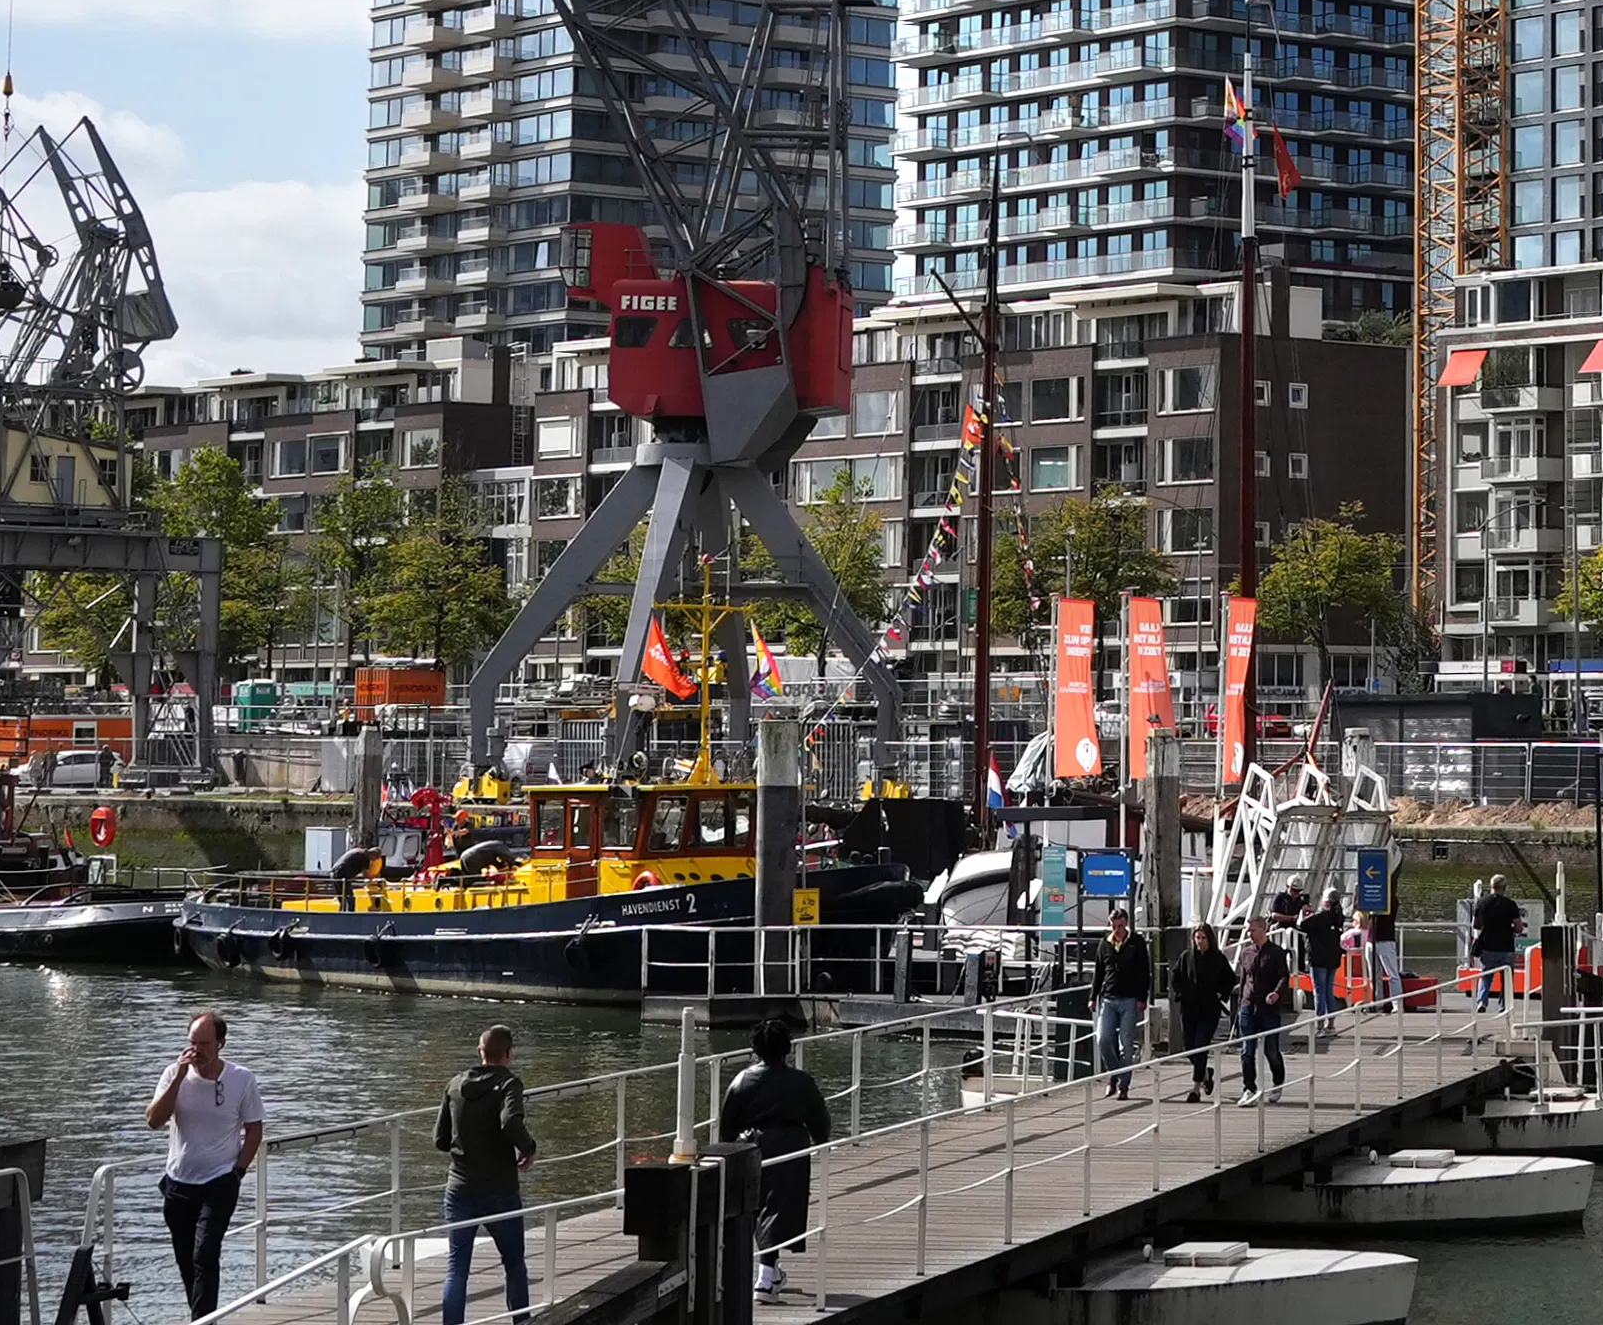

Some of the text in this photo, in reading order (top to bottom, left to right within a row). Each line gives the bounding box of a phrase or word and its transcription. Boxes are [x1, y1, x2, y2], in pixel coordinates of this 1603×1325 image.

[621, 295, 677, 311] FIGEE
[142, 905, 154, 913] N
[621, 893, 697, 916] HAVENDIENST 2
